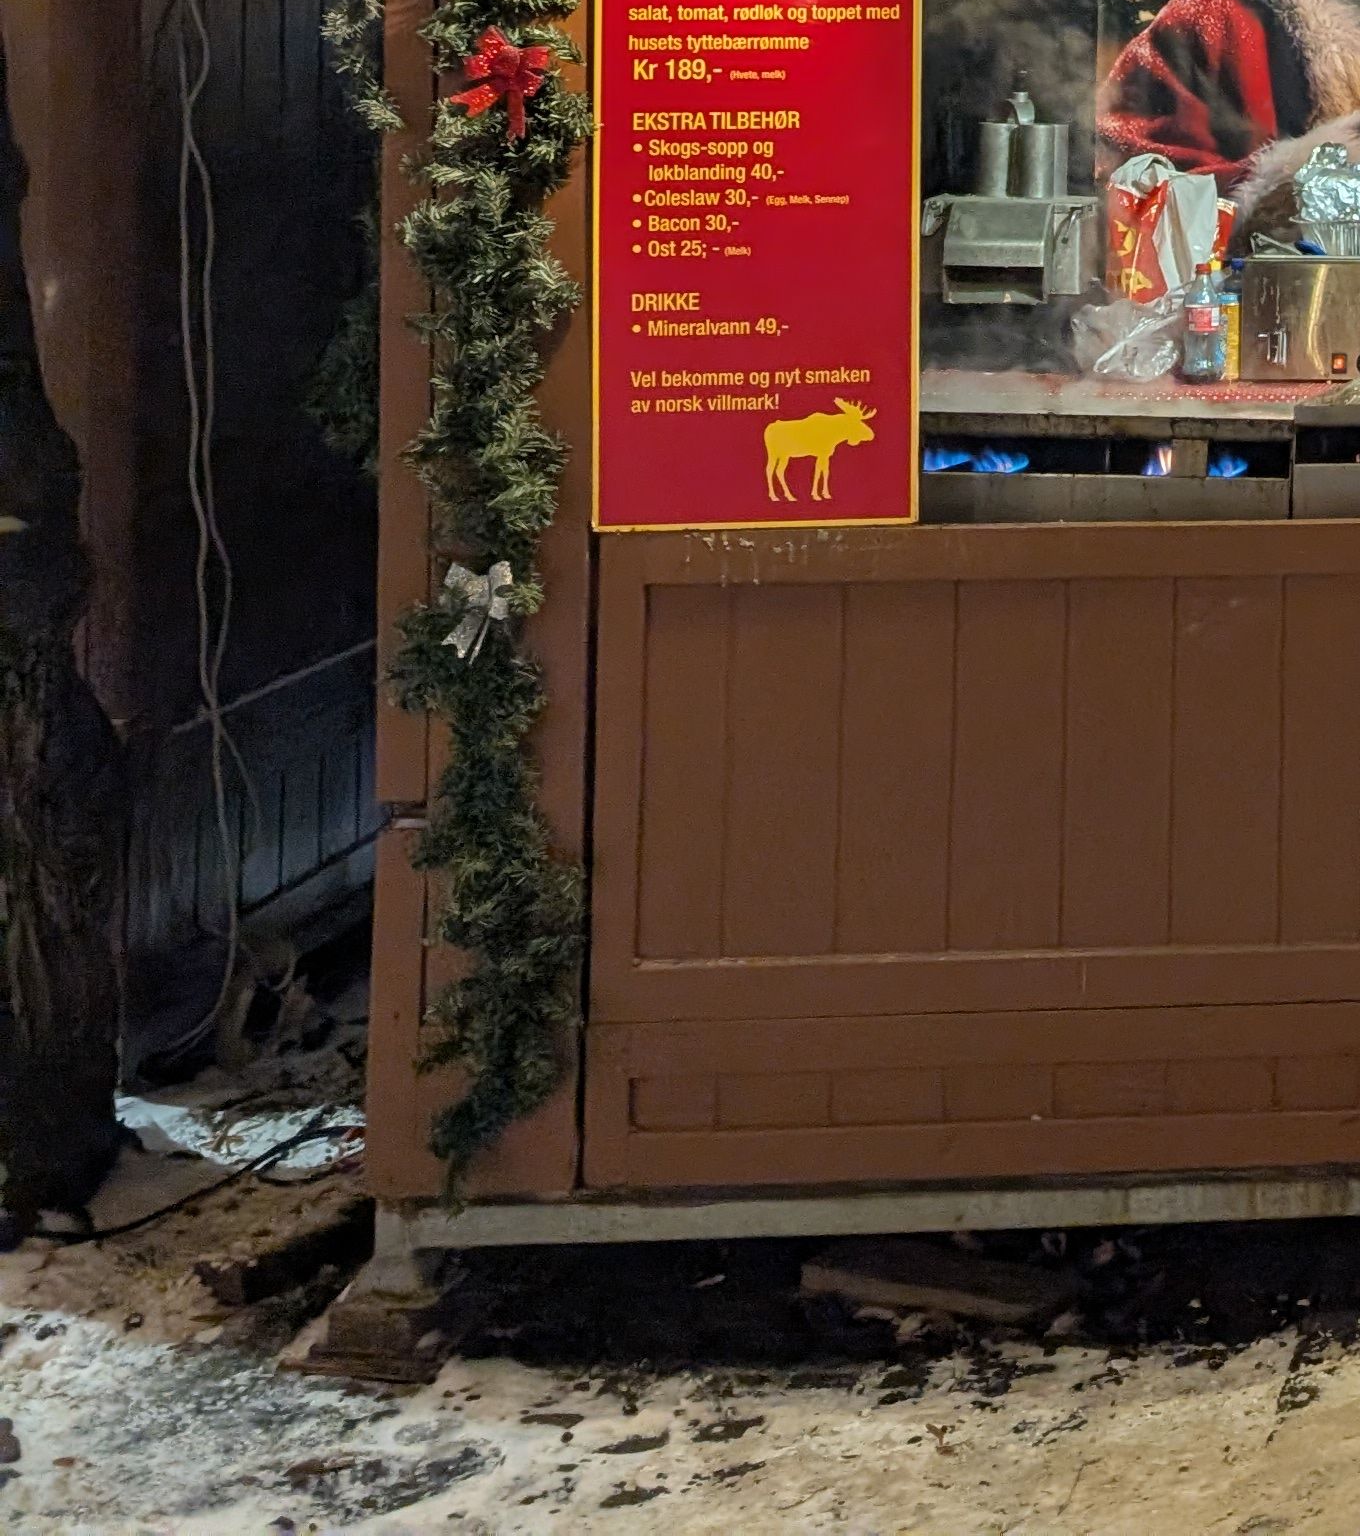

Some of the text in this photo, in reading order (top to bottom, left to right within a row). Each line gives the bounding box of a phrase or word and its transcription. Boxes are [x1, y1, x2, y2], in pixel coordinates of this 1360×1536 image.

[628, 3, 899, 22] salat, tomat, rødløk og toppet med
[628, 34, 809, 52] husets tyttebærrømme
[633, 60, 659, 80] Kr
[667, 60, 722, 83] 189,-
[633, 110, 800, 131] EKSTRA TILBEHØR
[649, 139, 773, 157] Skogs-sopp og
[649, 163, 784, 182] løkblanding 40,-
[644, 189, 719, 206] Coleslaw
[724, 188, 759, 206] 30,-
[648, 215, 739, 233] Bacon 30,-
[648, 240, 676, 257] Ost
[631, 293, 700, 311] DRIKKE
[648, 318, 788, 336] Mineralvann 49,-
[631, 367, 870, 388] Vel bekomme og nyt smaken
[631, 394, 779, 413] av norsk villmark!
